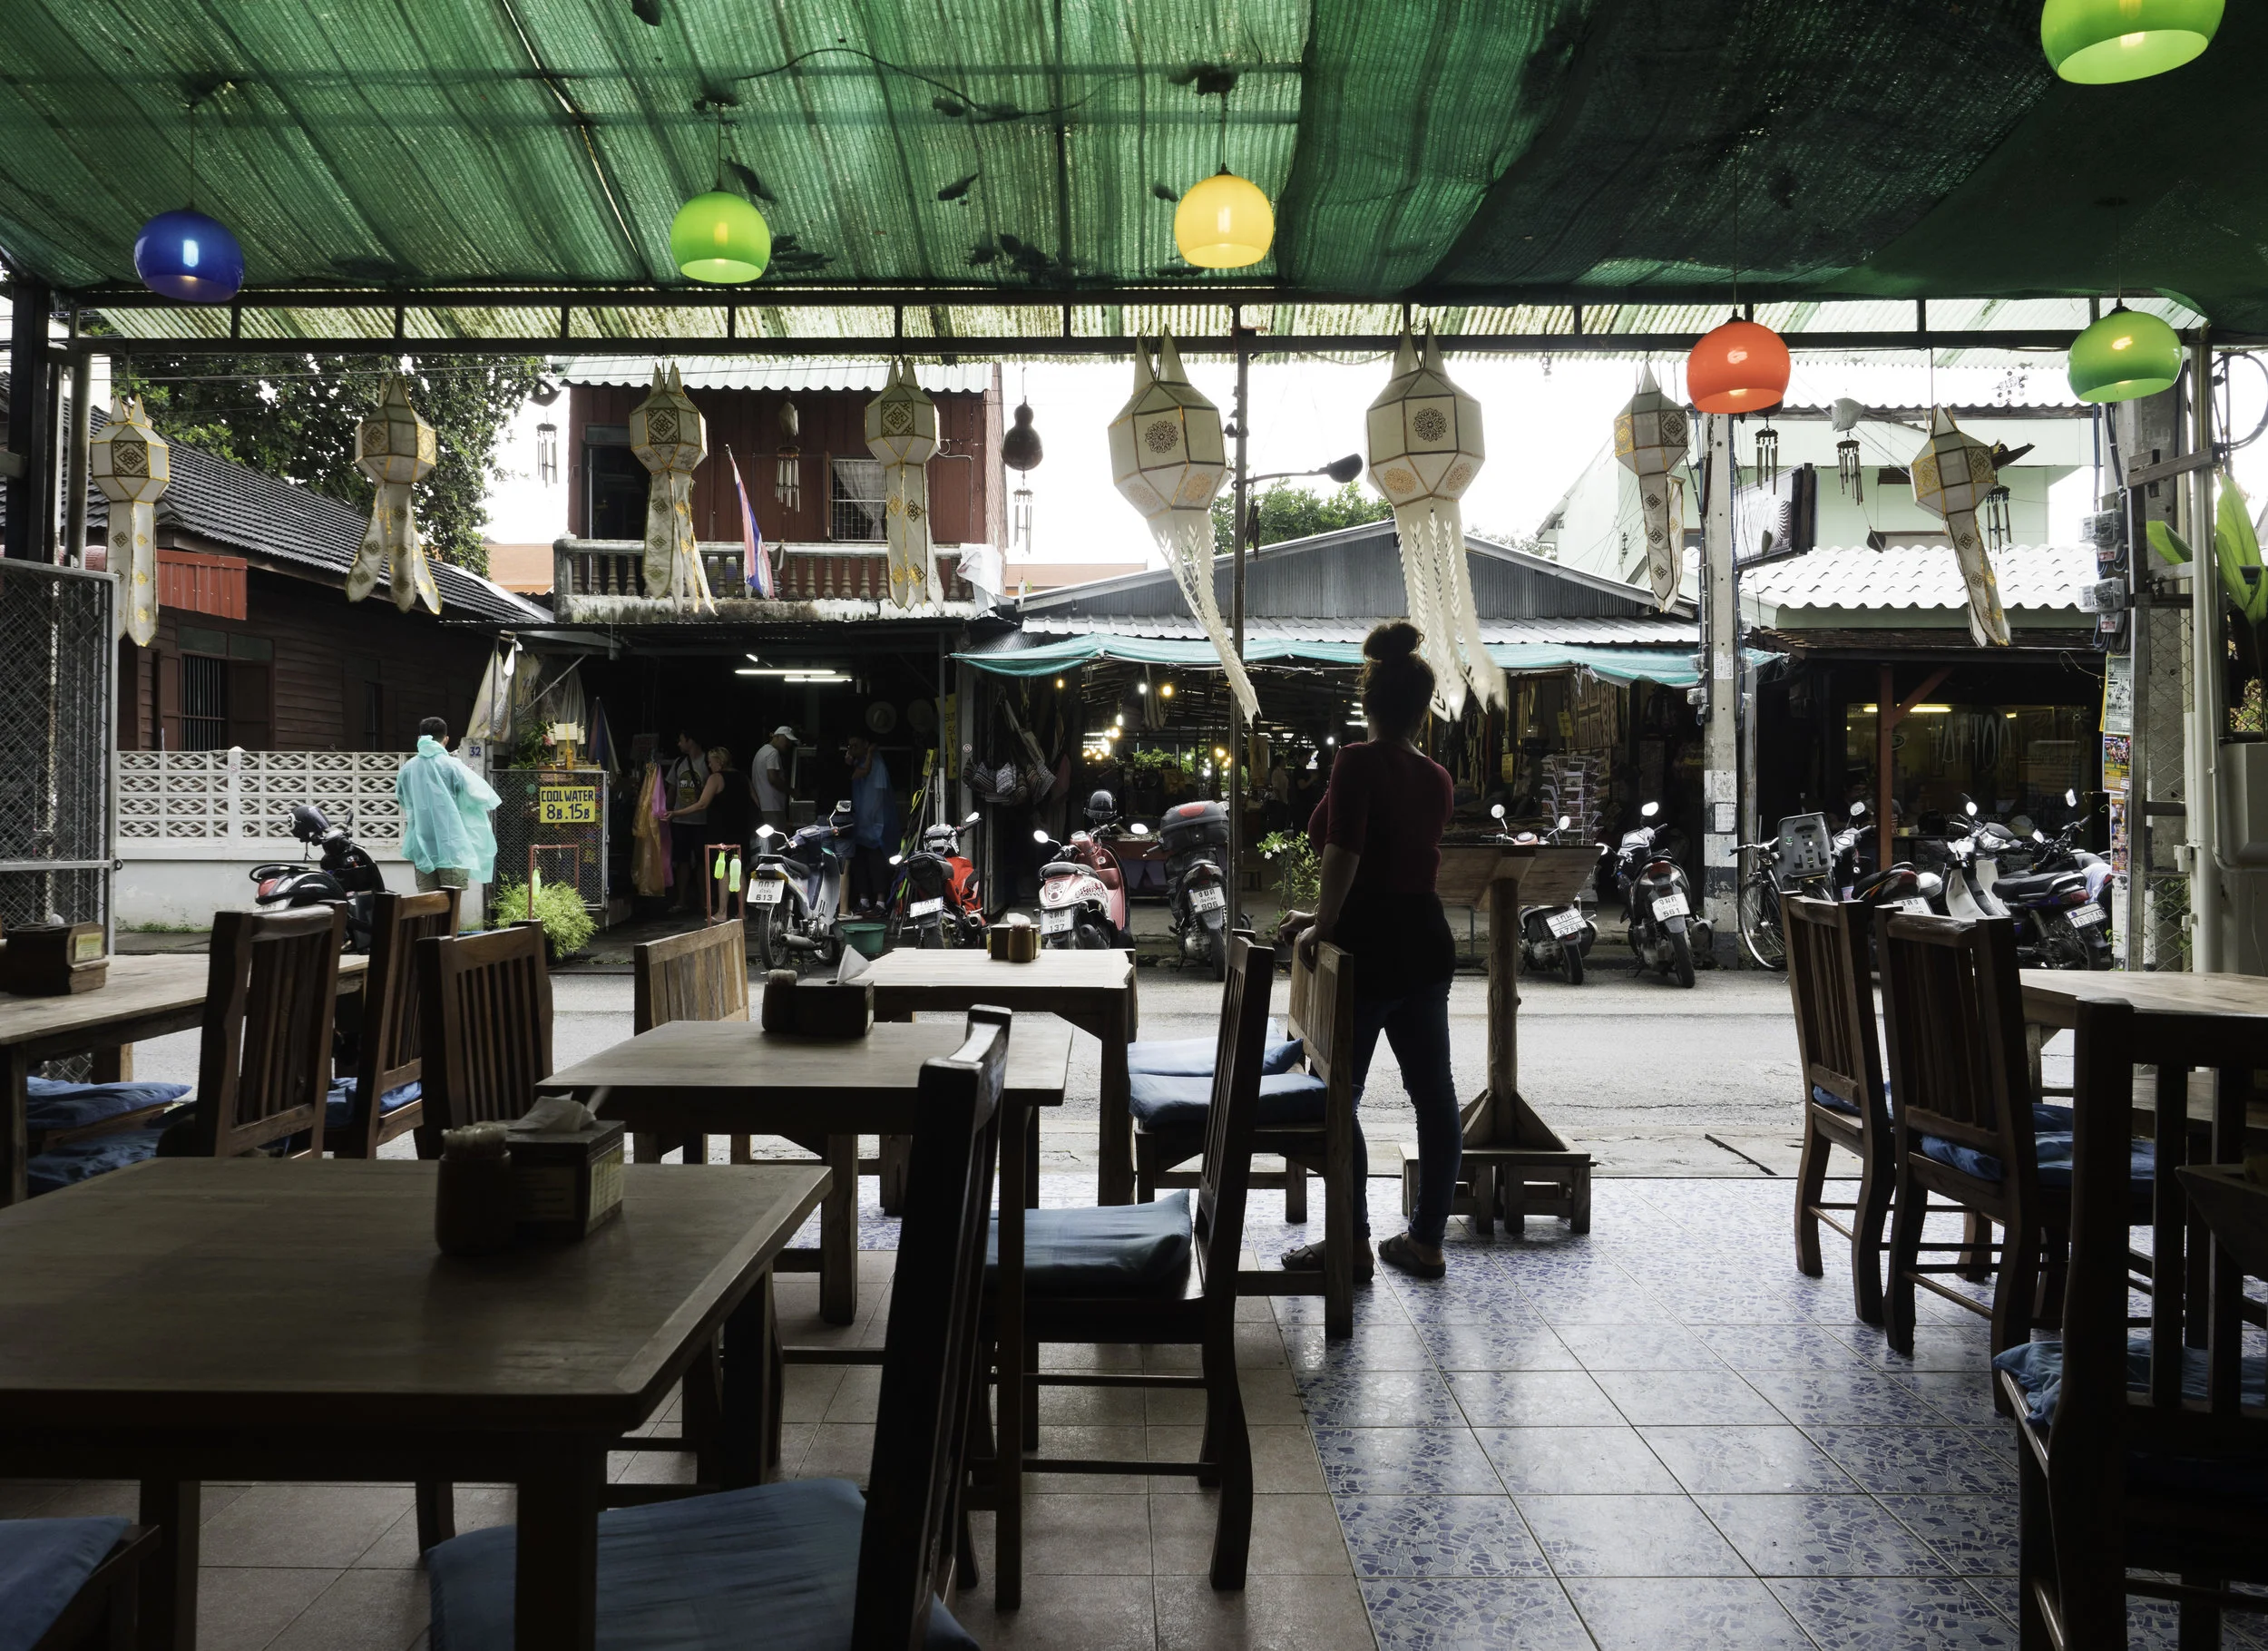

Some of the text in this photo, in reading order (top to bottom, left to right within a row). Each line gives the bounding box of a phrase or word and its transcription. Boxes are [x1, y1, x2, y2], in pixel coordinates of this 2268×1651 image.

[469, 747, 481, 757] 32
[542, 790, 594, 802] COOL WATER
[1050, 923, 1065, 932] 137
